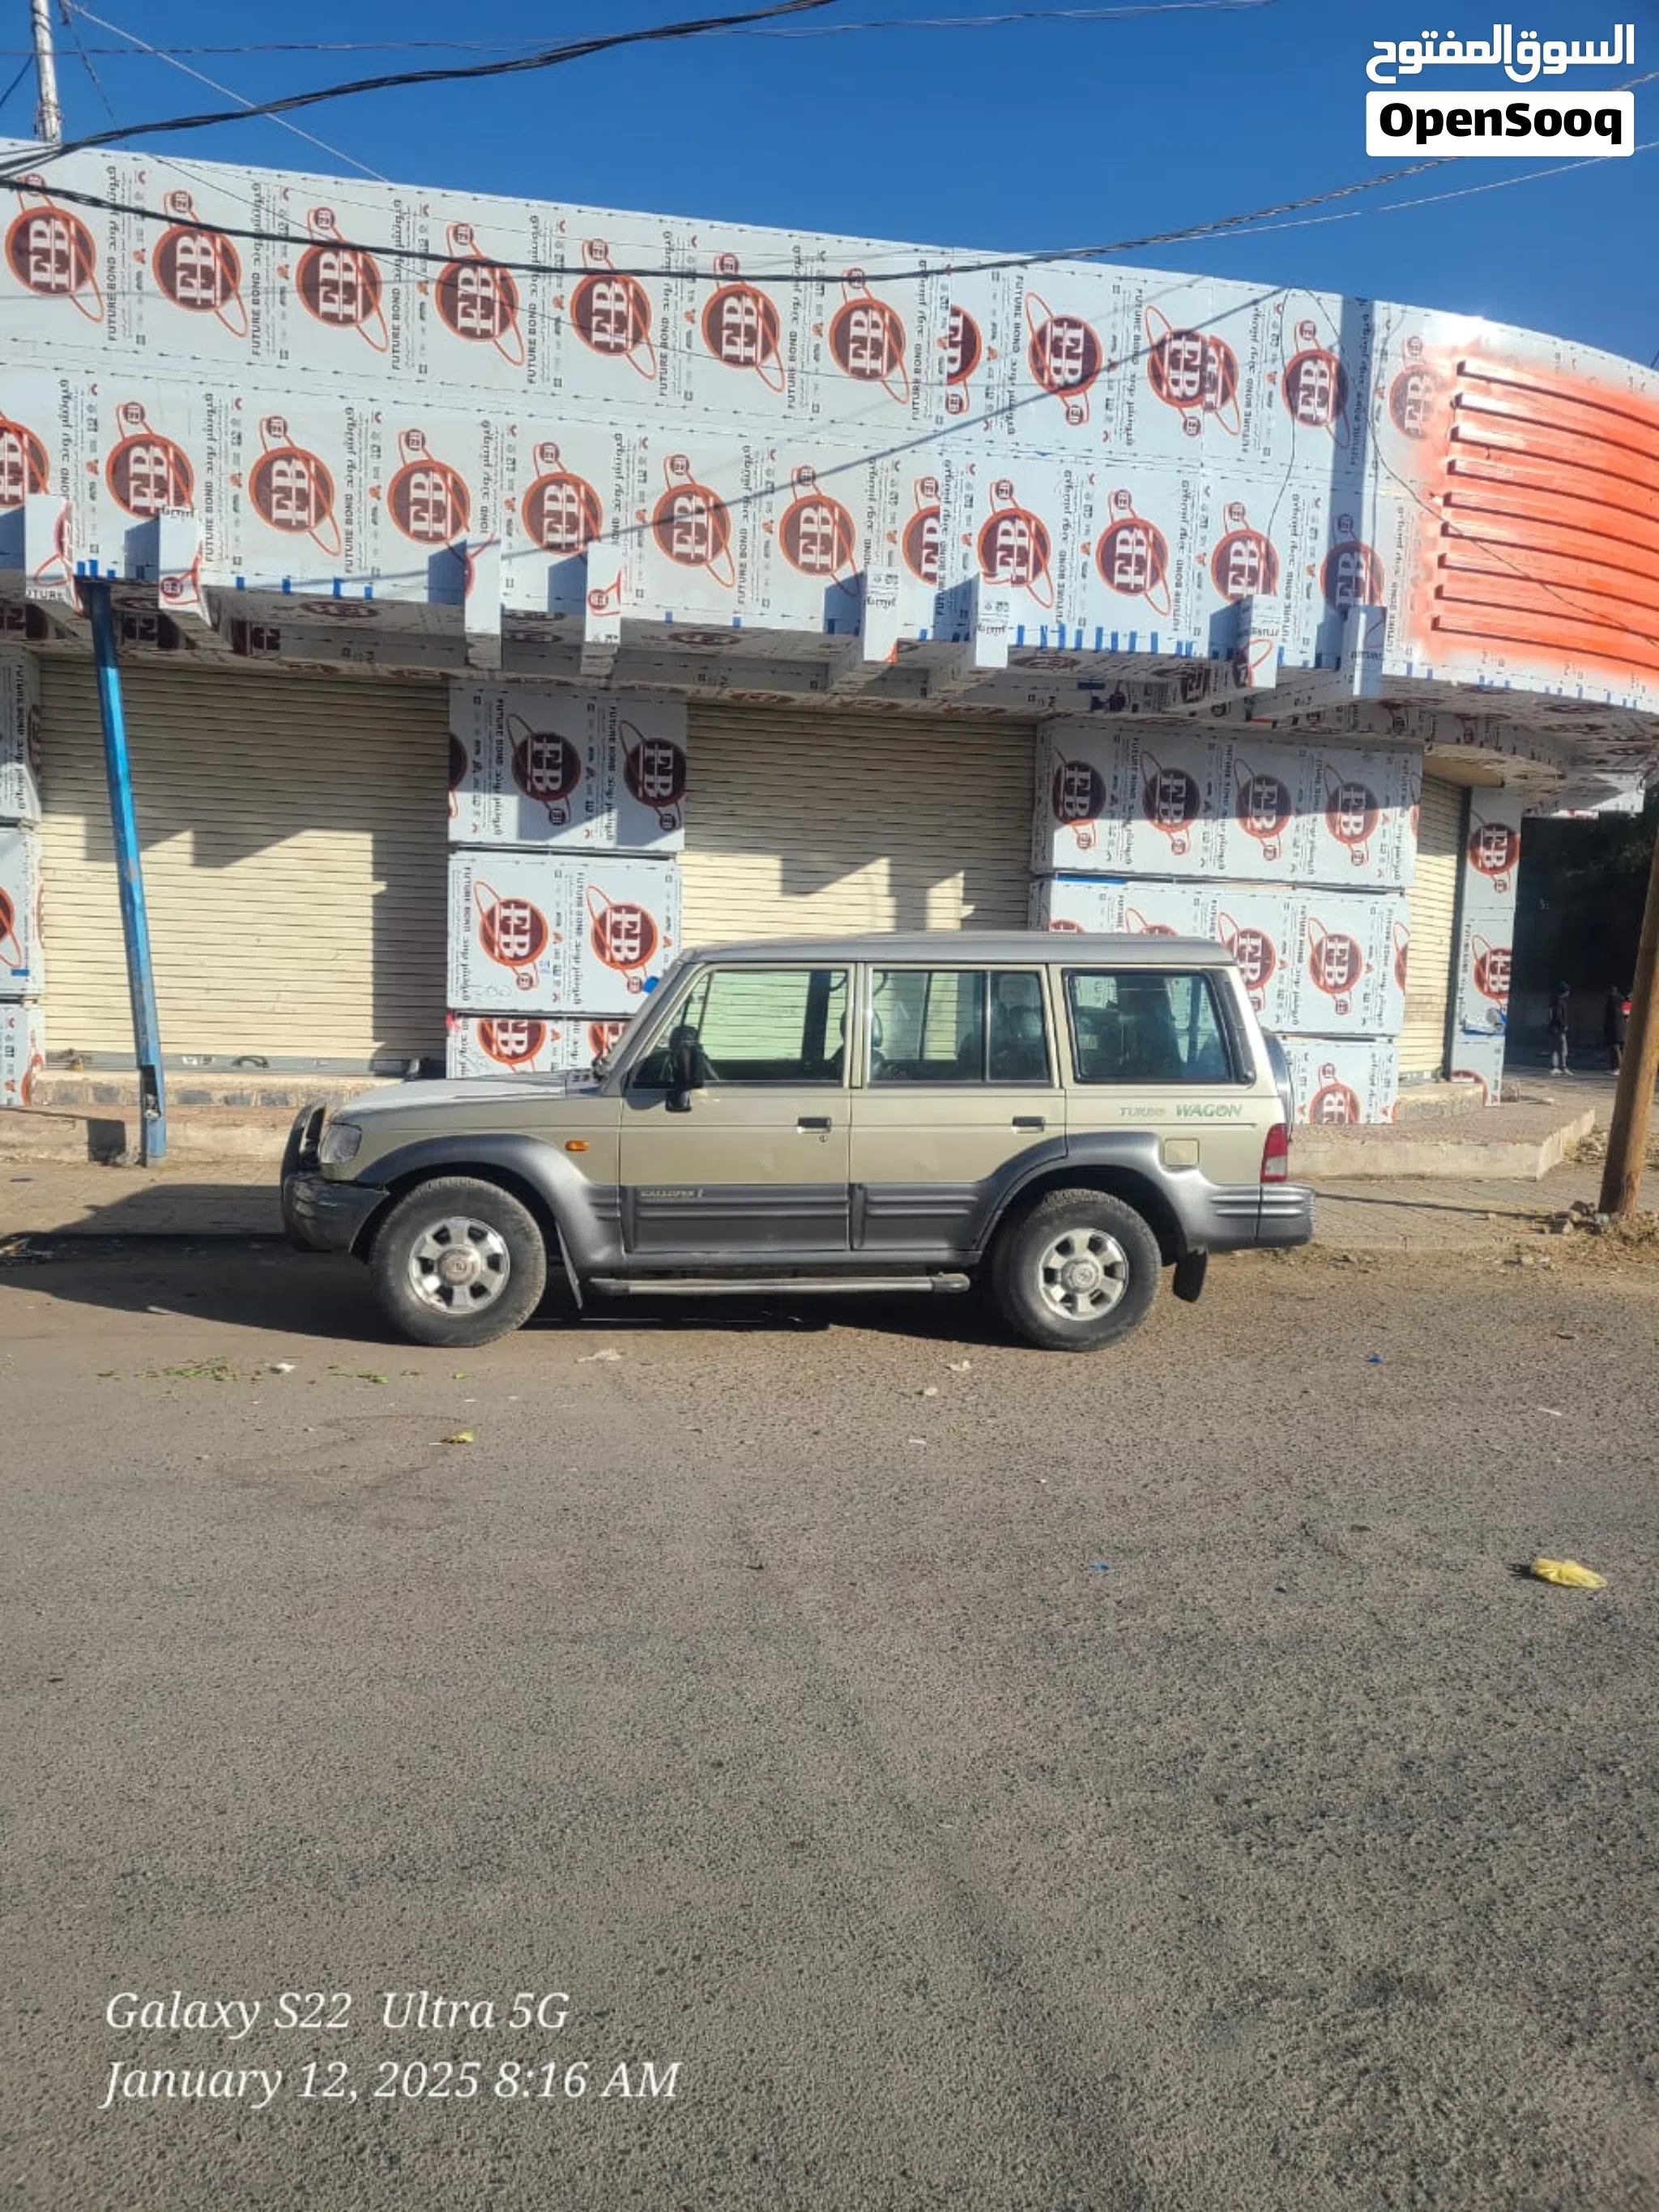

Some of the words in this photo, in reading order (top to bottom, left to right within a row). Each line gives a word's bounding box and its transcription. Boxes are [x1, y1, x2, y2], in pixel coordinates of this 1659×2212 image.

[29, 216, 71, 290] FB
[176, 234, 215, 305] FB
[252, 273, 261, 305] BOND
[392, 288, 401, 320] BOND
[252, 310, 261, 356] FUTURE
[527, 304, 536, 336] BOND
[591, 280, 627, 350] FB
[659, 317, 668, 347] BOND
[721, 293, 757, 364] FB
[392, 325, 401, 370] FUTURE
[527, 340, 536, 384] FUTURE
[787, 331, 797, 361] BOND
[848, 308, 883, 376] FB
[912, 343, 923, 373] BOND
[659, 352, 668, 396] FUTURE
[787, 366, 797, 408] FUTURE
[912, 377, 923, 420] FUTURE
[130, 445, 168, 513] FB
[205, 481, 214, 513] BOND
[271, 458, 309, 526] FB
[345, 494, 354, 526] BOND
[409, 471, 447, 537] FB
[544, 484, 580, 550] FB
[206, 518, 214, 562] FUTURE
[345, 529, 354, 573] FUTURE
[799, 505, 834, 570] FB
[1115, 526, 1148, 590] FB
[1176, 1104, 1243, 1117] WAGON
